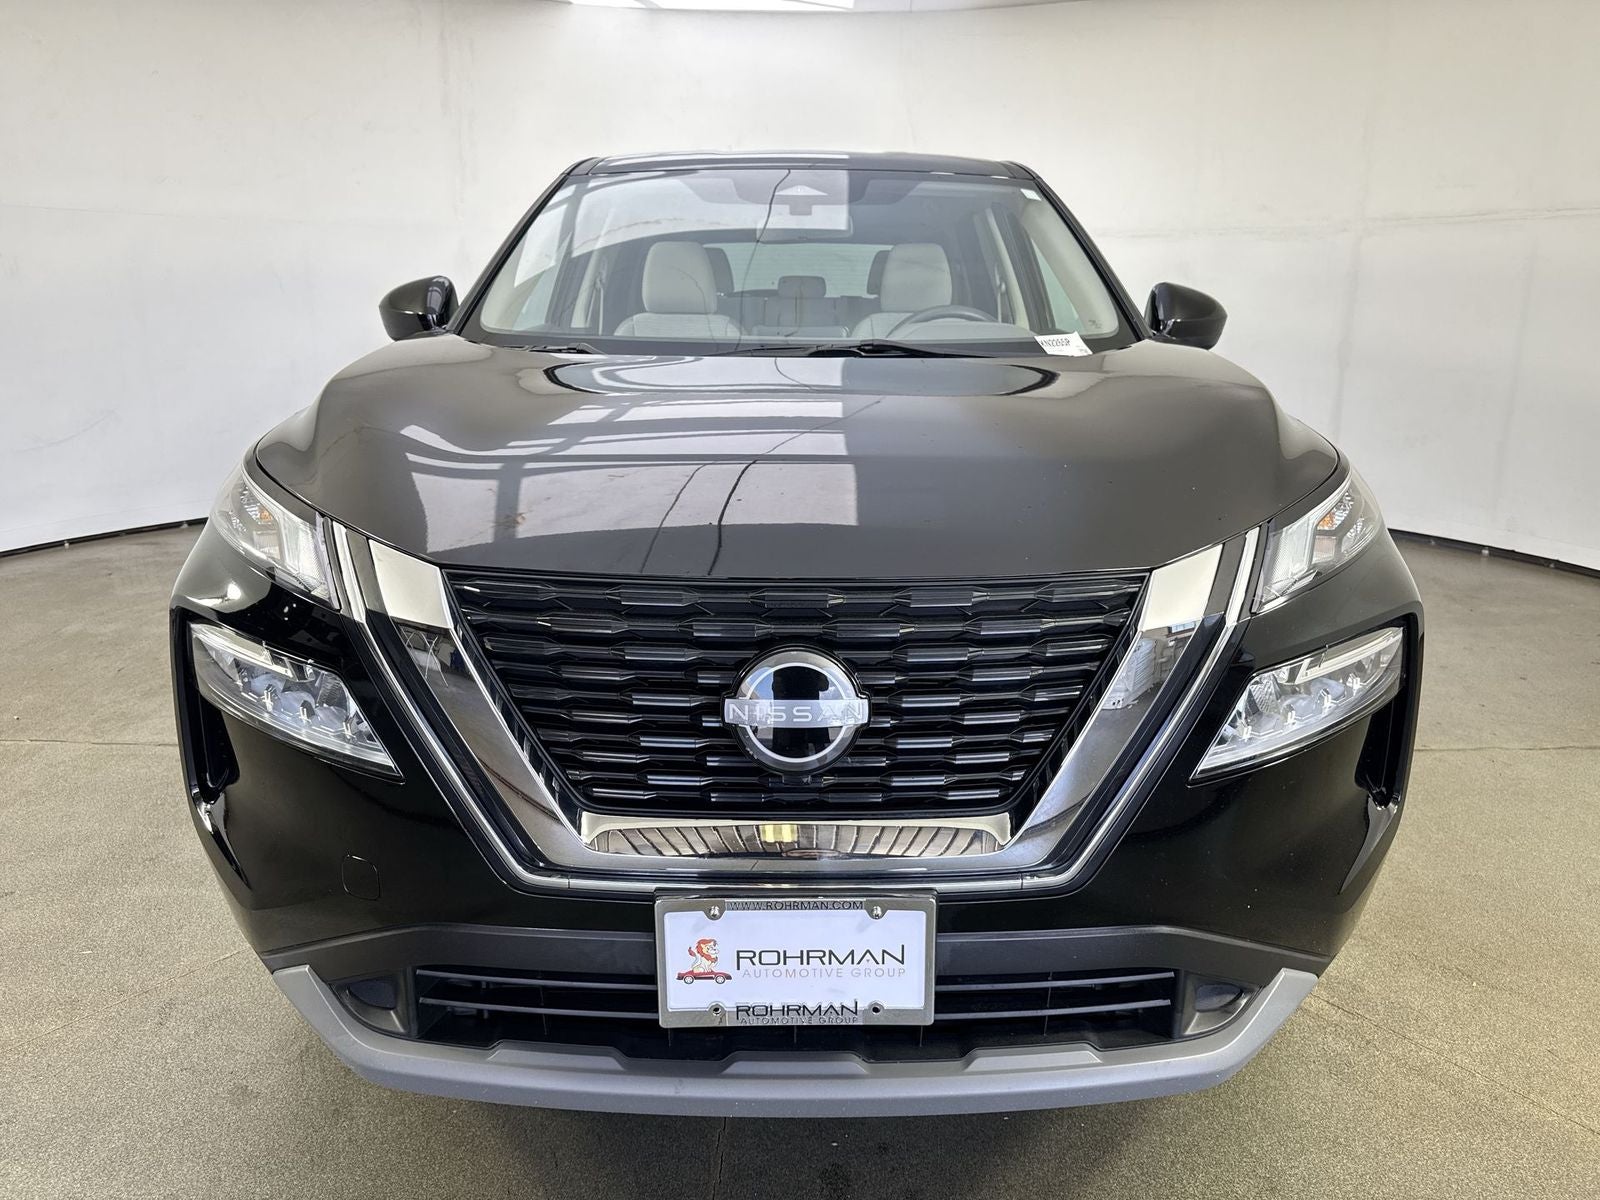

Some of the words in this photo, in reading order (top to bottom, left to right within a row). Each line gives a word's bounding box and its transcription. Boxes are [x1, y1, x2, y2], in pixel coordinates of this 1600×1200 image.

[728, 703, 863, 722] NISSAN
[727, 901, 864, 911] WWW.ROHRMAN.COM
[736, 944, 905, 971] ROHRMAN
[742, 968, 844, 979] AUTOMOTIVE
[850, 967, 906, 978] GROUP
[736, 1000, 858, 1020] ROHRMAN
[740, 1016, 813, 1025] AUTOMOTIVE
[818, 1016, 858, 1025] GROUP
